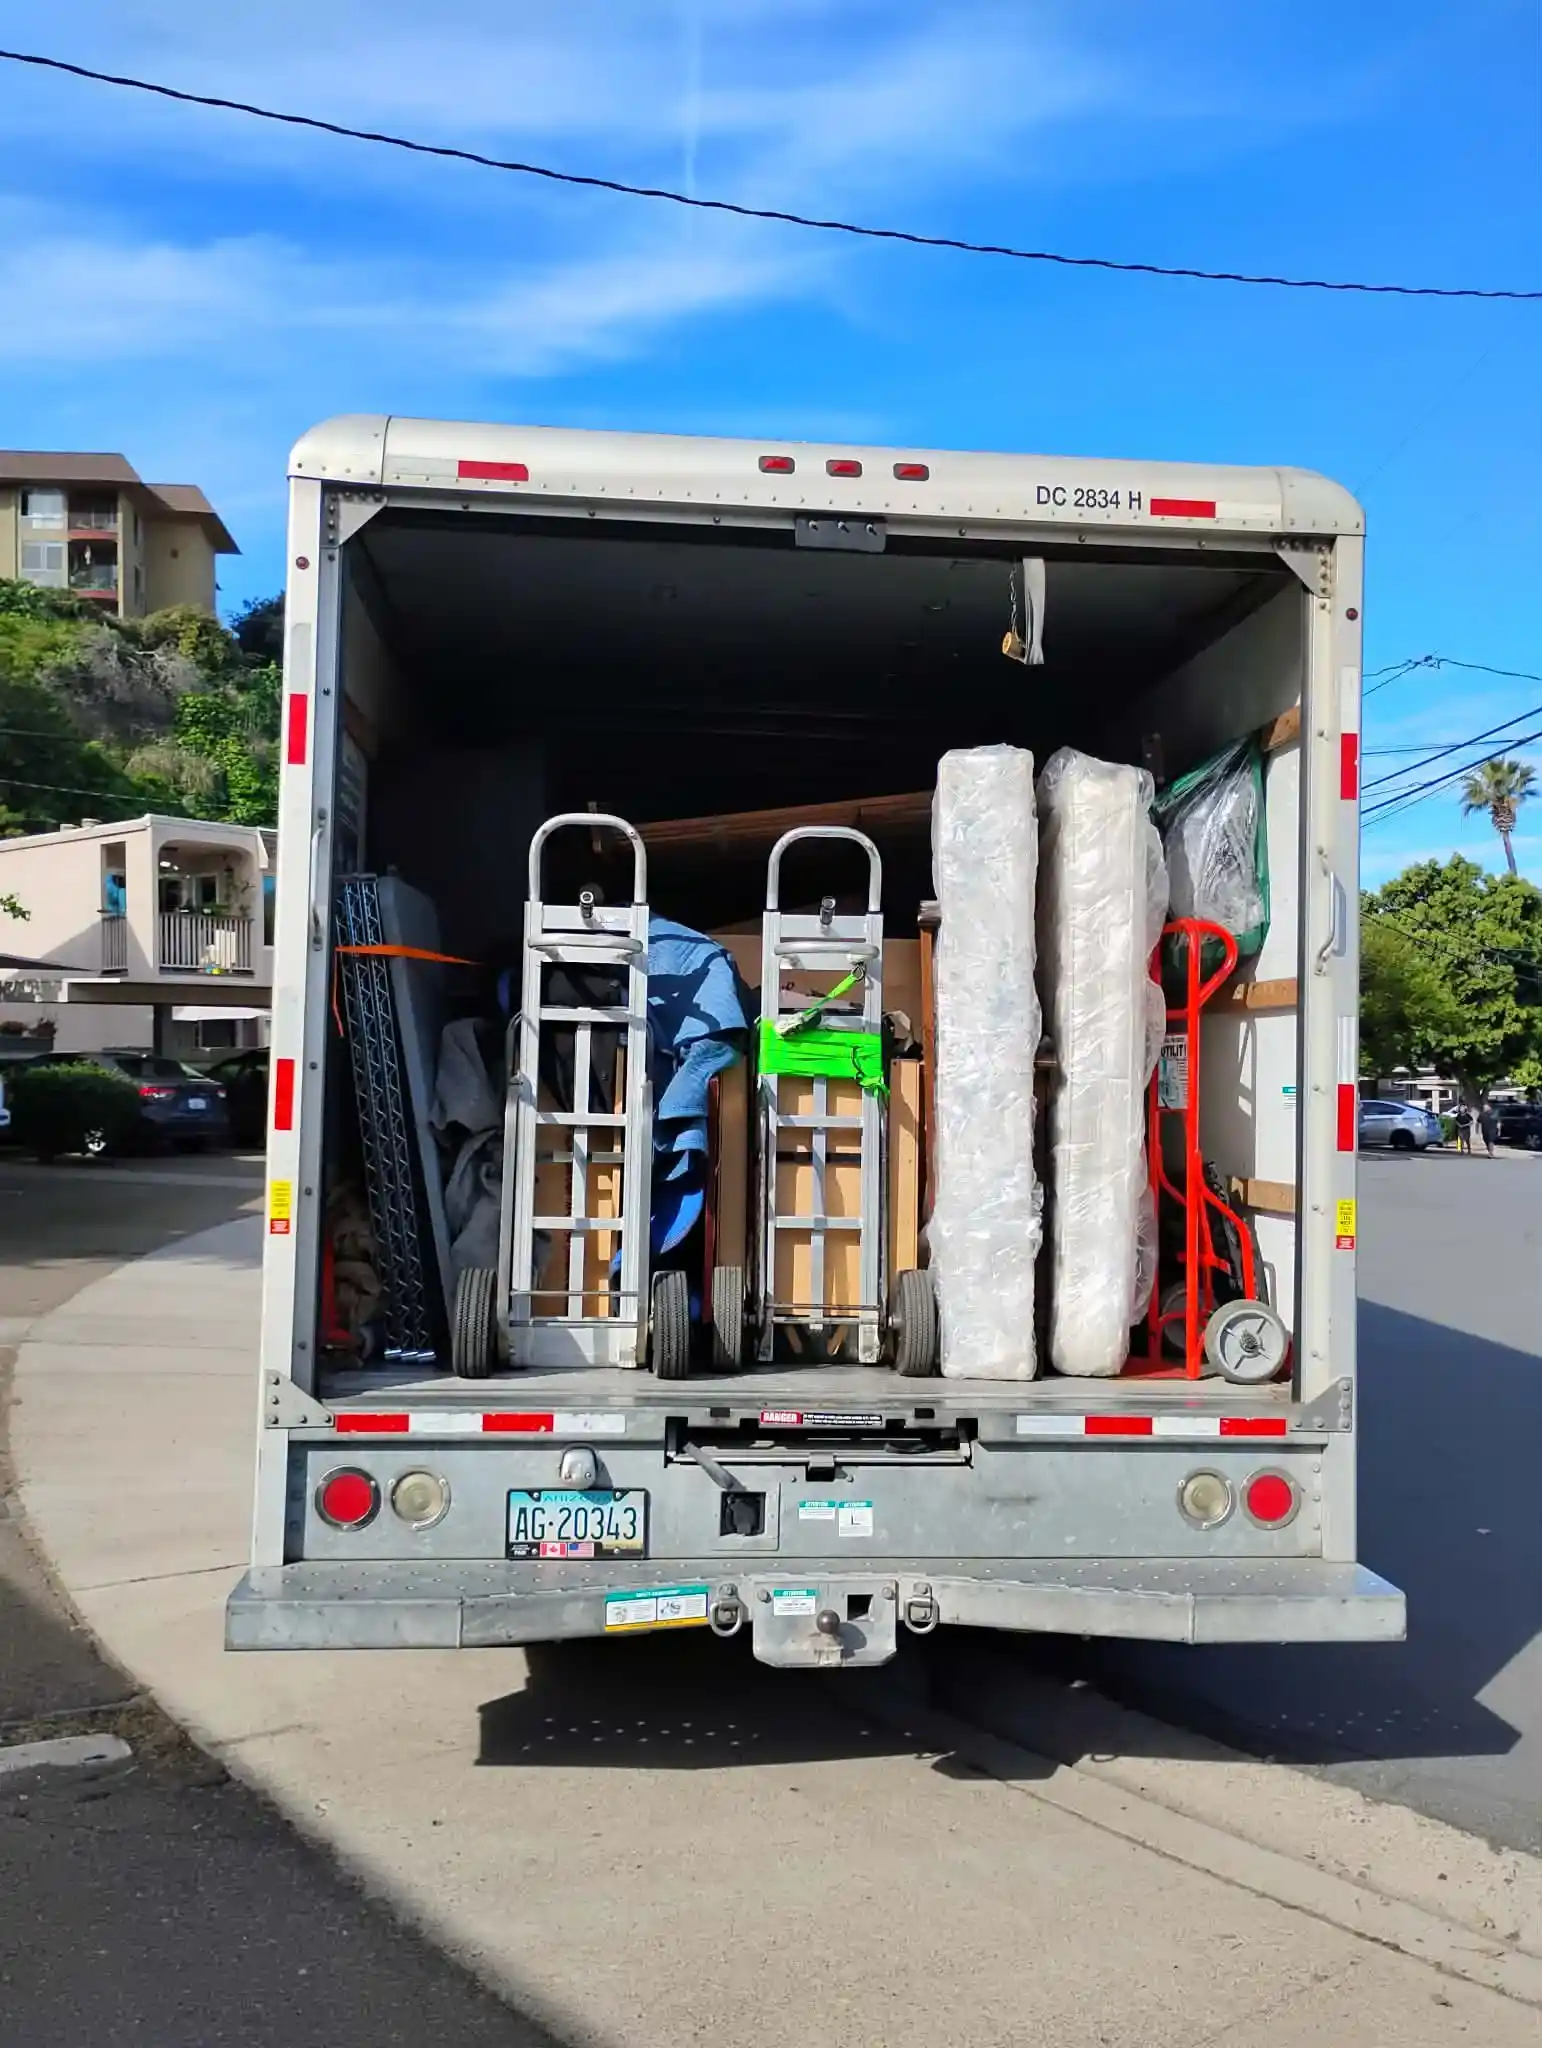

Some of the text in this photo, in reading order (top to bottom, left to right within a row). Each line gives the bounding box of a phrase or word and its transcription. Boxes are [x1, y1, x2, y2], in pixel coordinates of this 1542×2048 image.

[1036, 485, 1142, 511] DC 2834 H
[763, 1411, 798, 1423] DANGER
